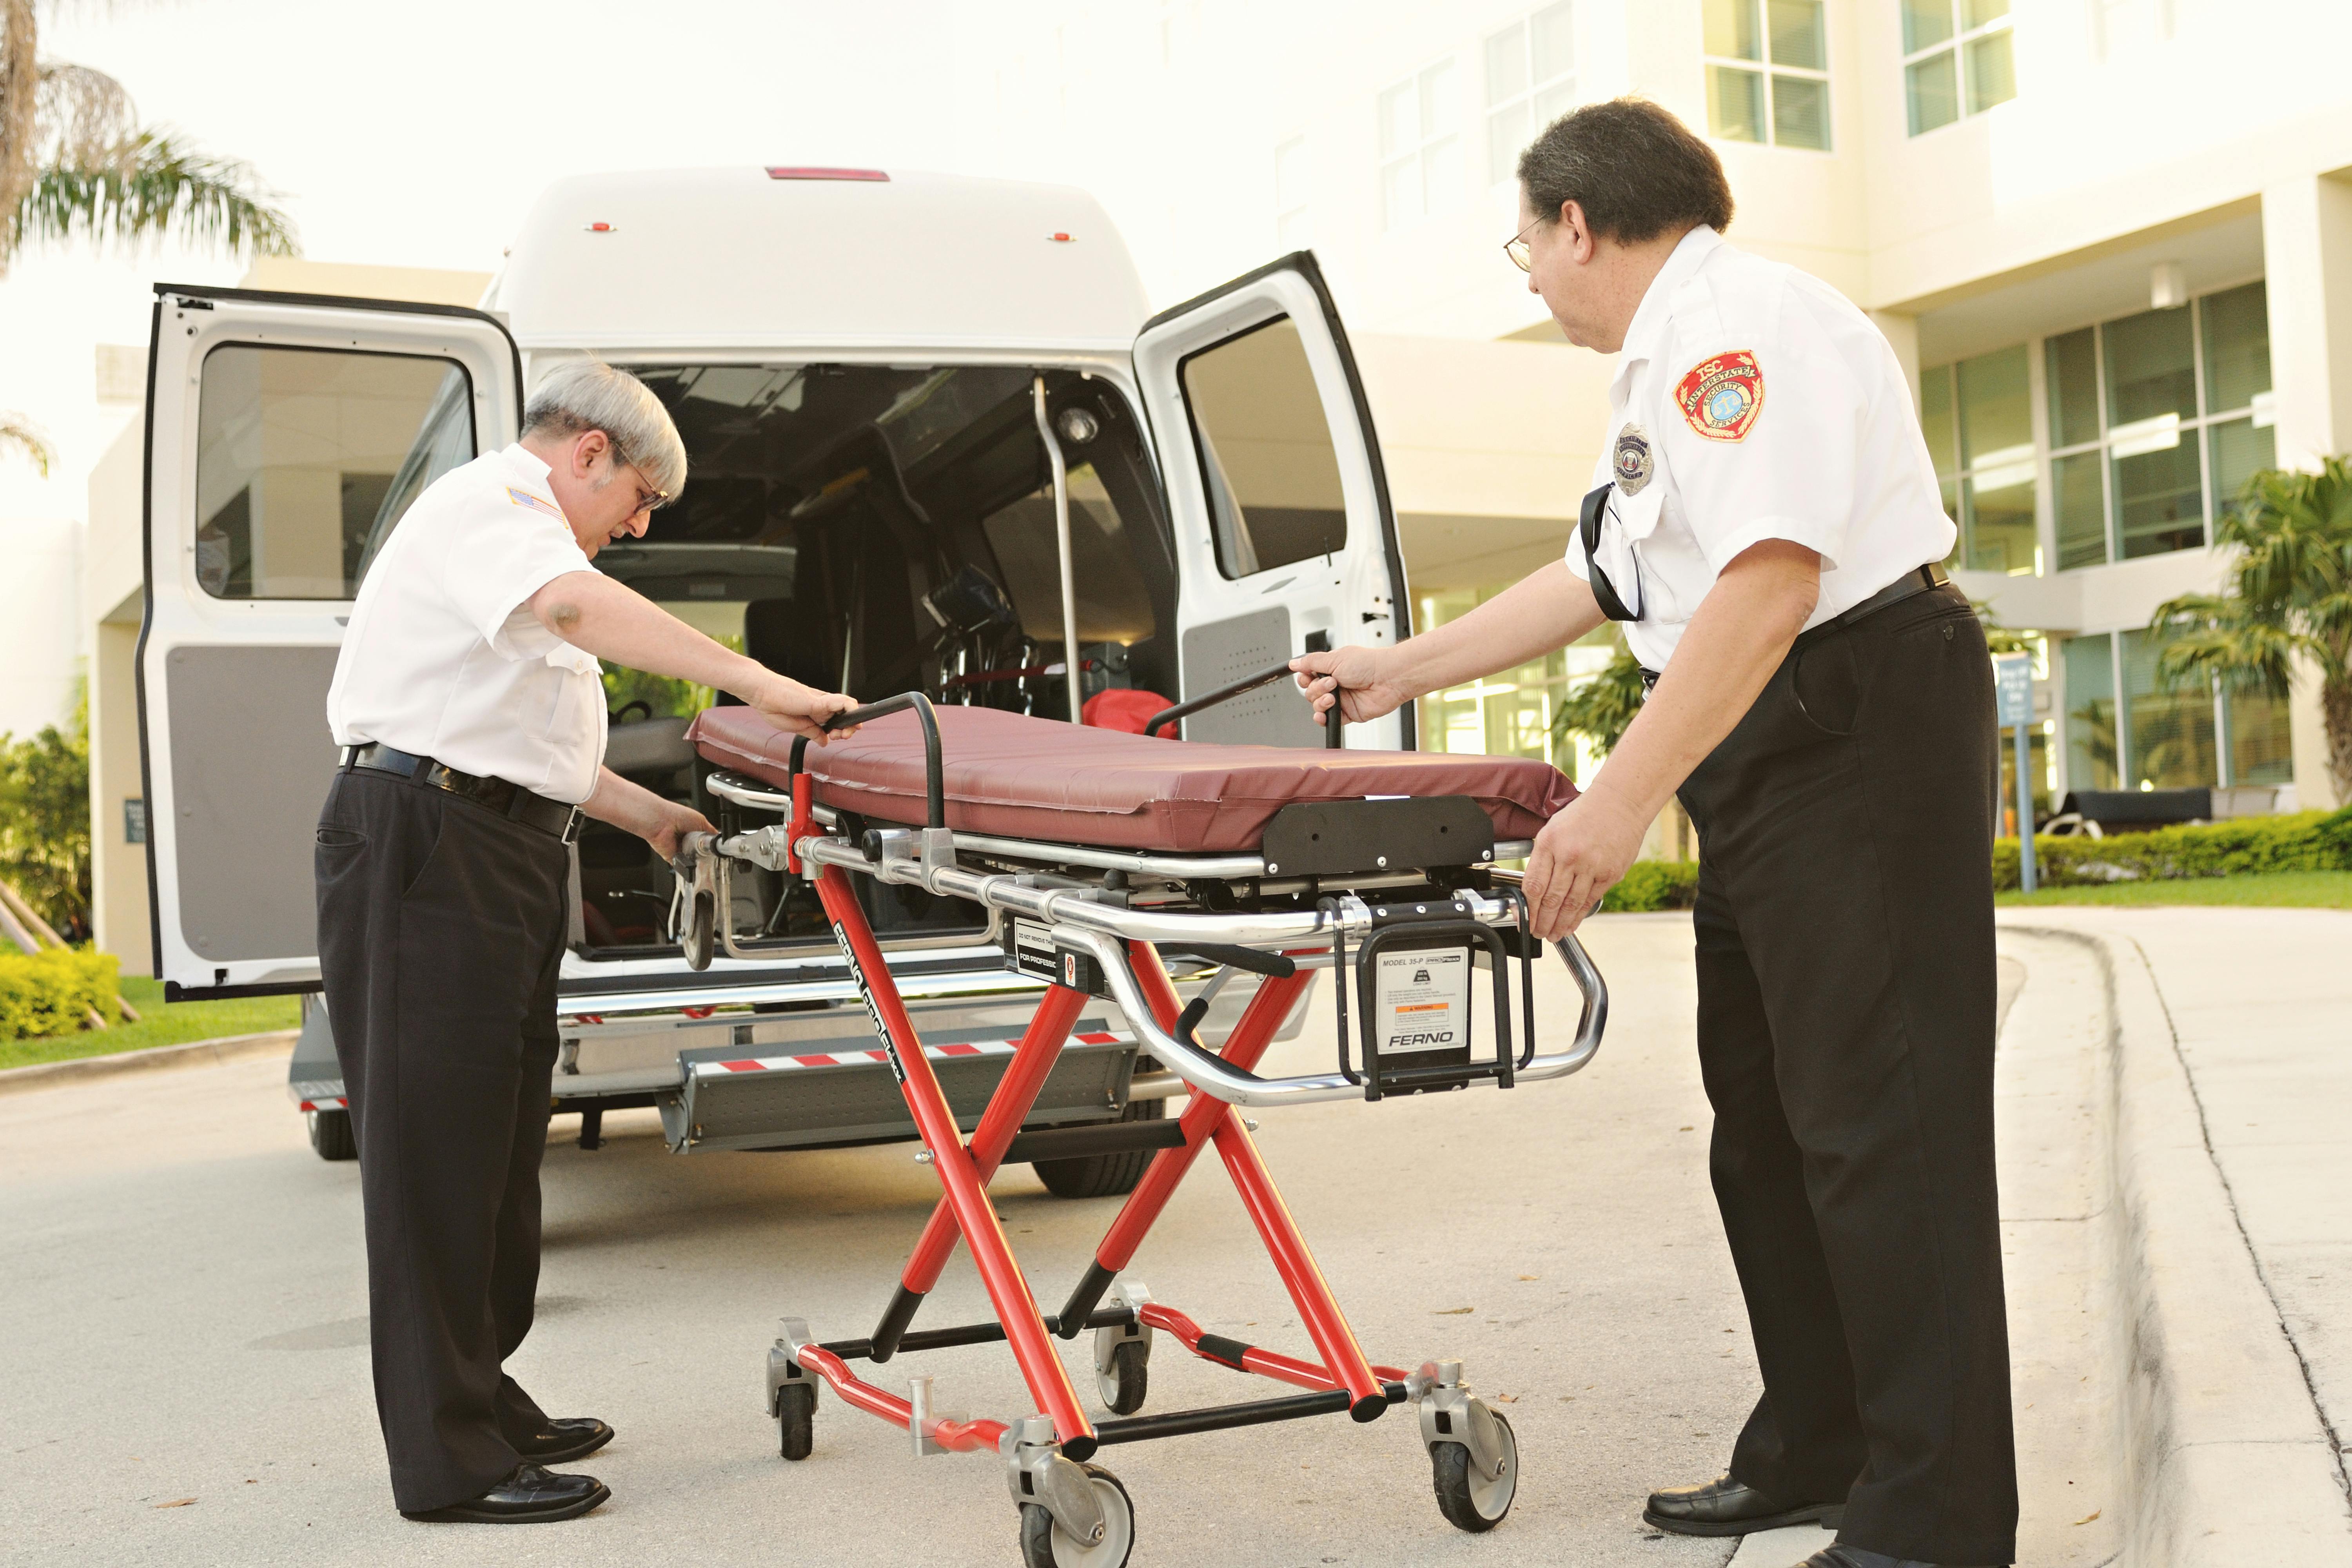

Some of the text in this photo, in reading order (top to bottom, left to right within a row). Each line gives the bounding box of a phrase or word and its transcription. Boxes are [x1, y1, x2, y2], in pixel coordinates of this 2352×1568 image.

[1696, 360, 1723, 383] ISC
[1688, 367, 1748, 405] INTERSTATE
[1704, 382, 1742, 406] SECURITY
[1710, 402, 1750, 427] SERVICES
[1621, 436, 1648, 447] SECURITY
[1618, 467, 1641, 479] OFFICER
[833, 922, 863, 989] FERNO
[1020, 953, 1030, 962] FOR
[1389, 1032, 1454, 1047] FERNO
